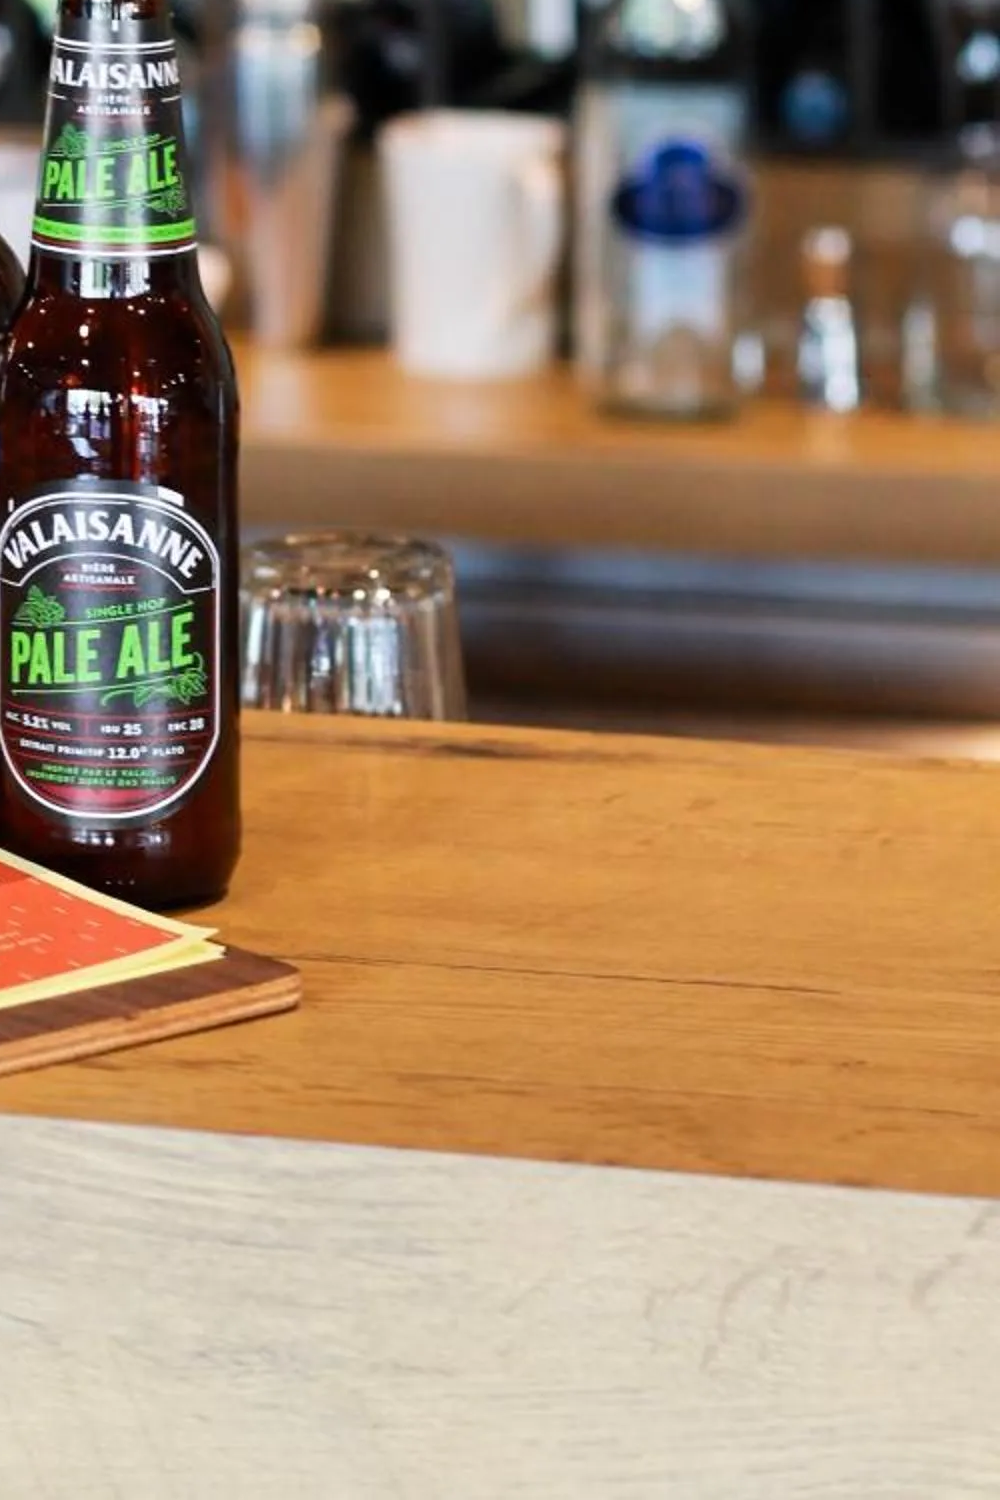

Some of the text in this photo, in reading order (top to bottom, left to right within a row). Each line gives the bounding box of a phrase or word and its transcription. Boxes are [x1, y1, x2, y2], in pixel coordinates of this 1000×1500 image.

[43, 144, 178, 200] PALE ALE
[3, 510, 204, 580] VALAISANNE
[63, 573, 136, 585] ARTISANALE
[85, 597, 167, 619] SINGLE HOP
[10, 611, 195, 685] PALE ALE
[123, 723, 143, 736] 25
